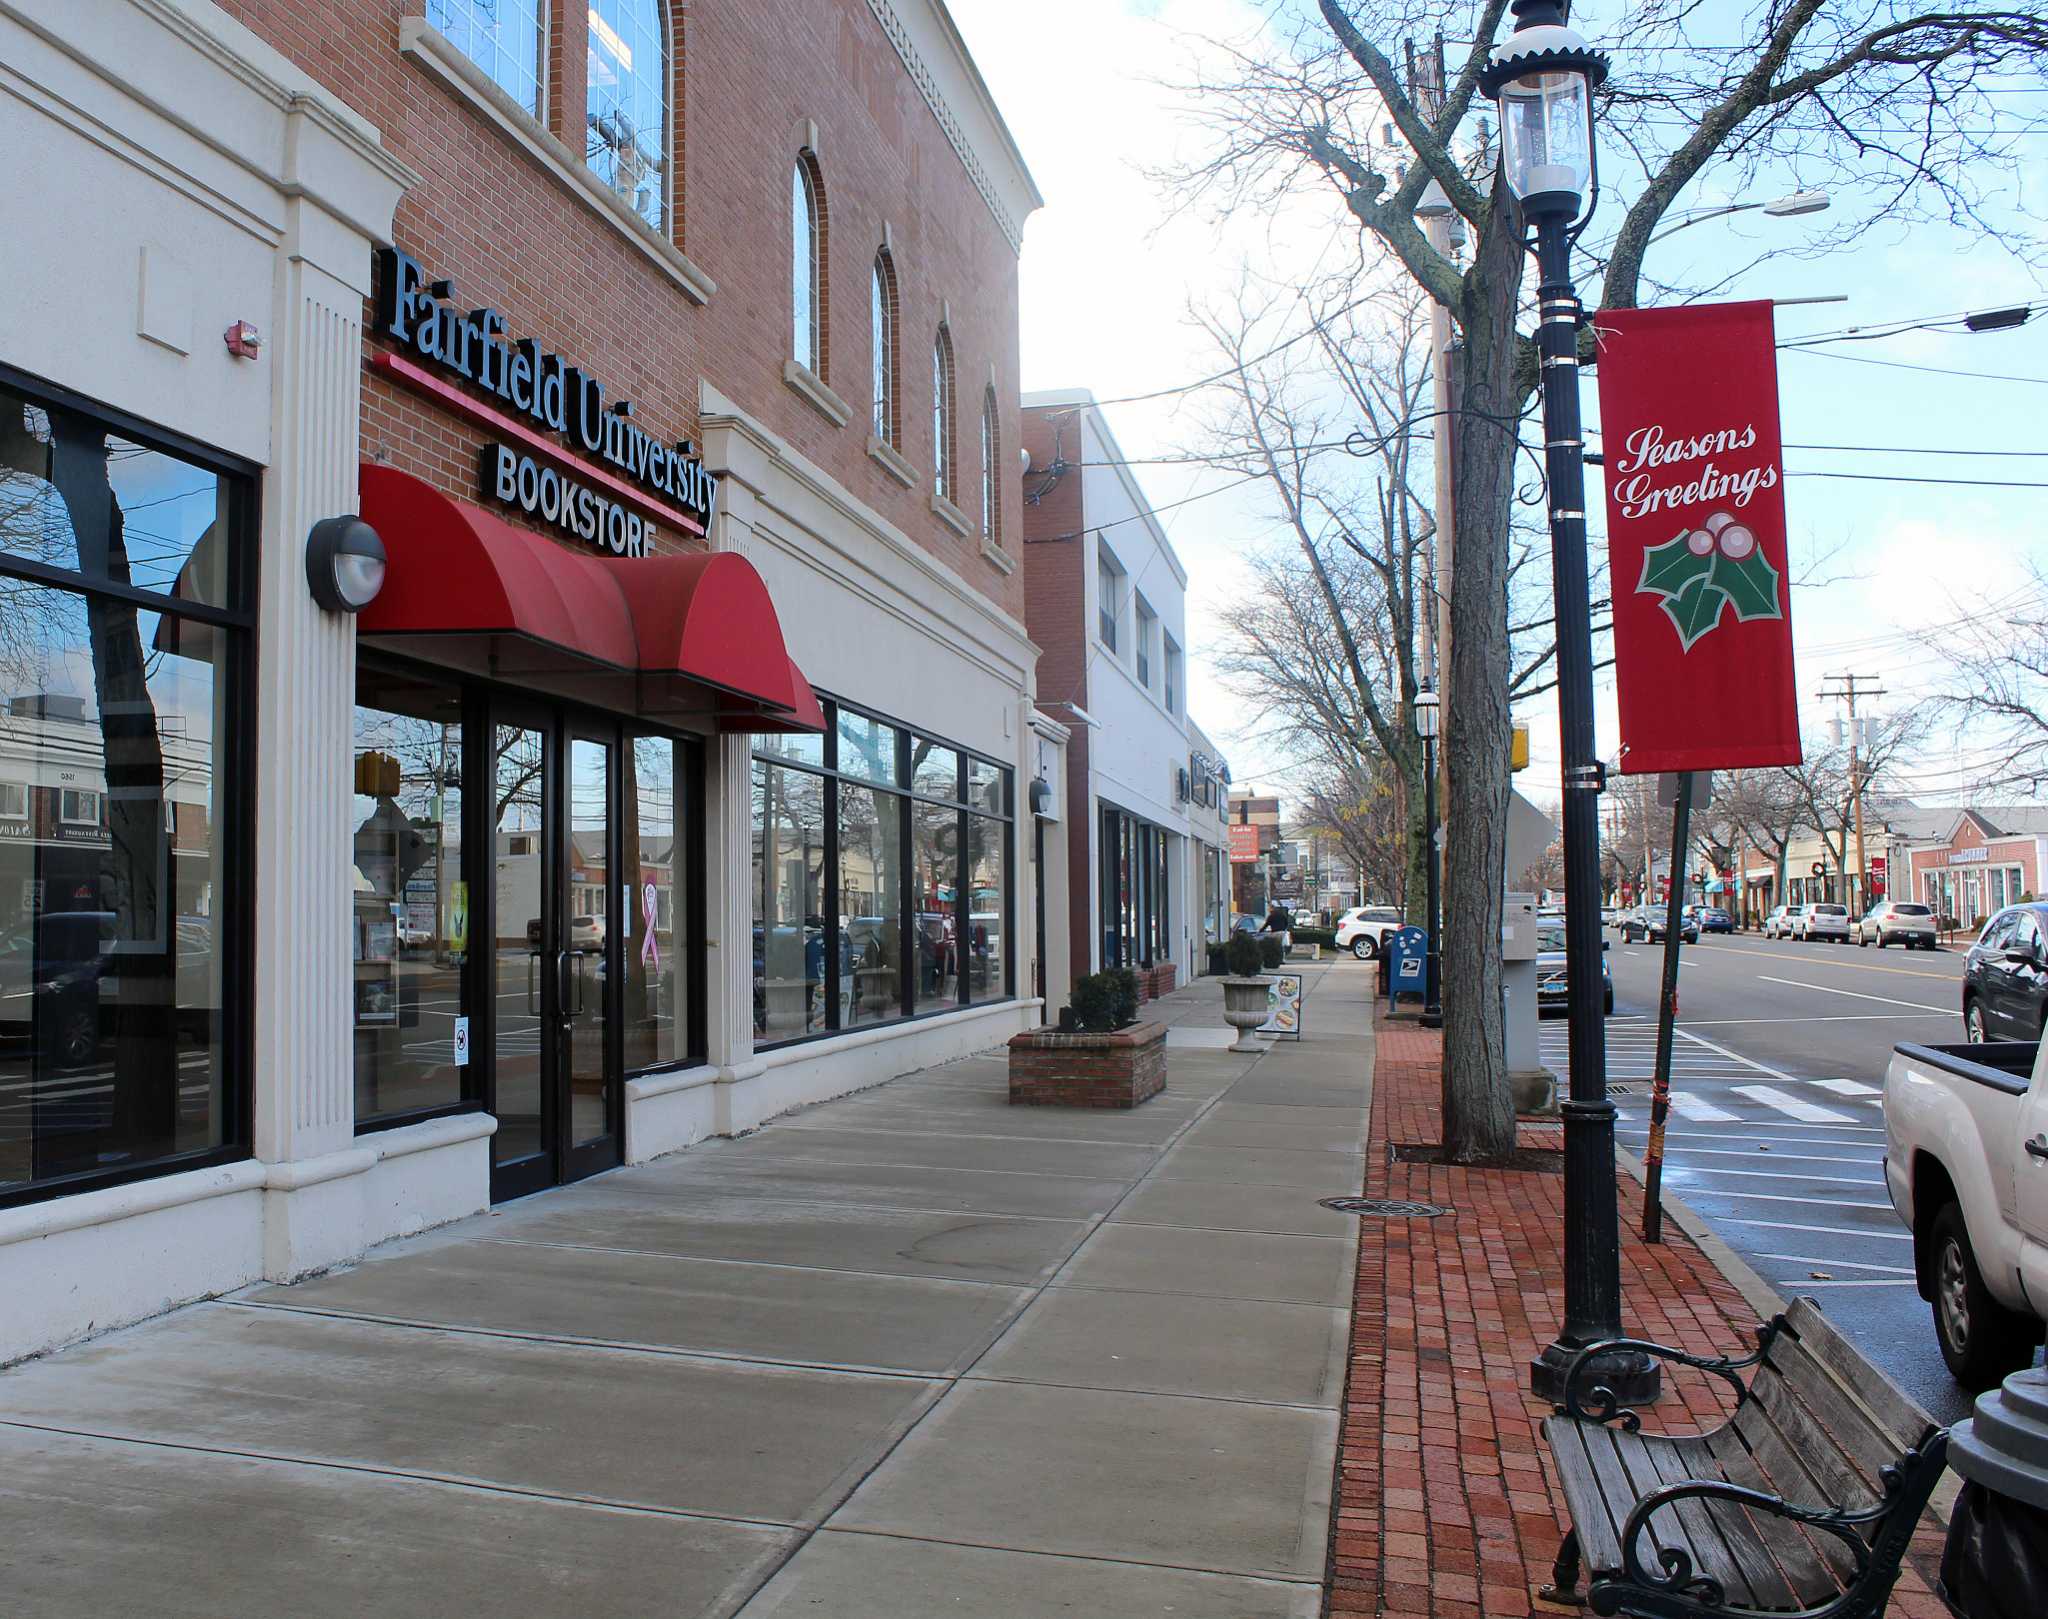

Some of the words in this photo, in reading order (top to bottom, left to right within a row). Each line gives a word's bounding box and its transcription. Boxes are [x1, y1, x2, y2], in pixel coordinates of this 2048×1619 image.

[389, 244, 567, 432] Fairfield
[577, 370, 719, 540] University
[1617, 424, 1756, 473] Seasons
[496, 446, 656, 558] BOOKSTORE
[1614, 463, 1777, 519] Greetings
